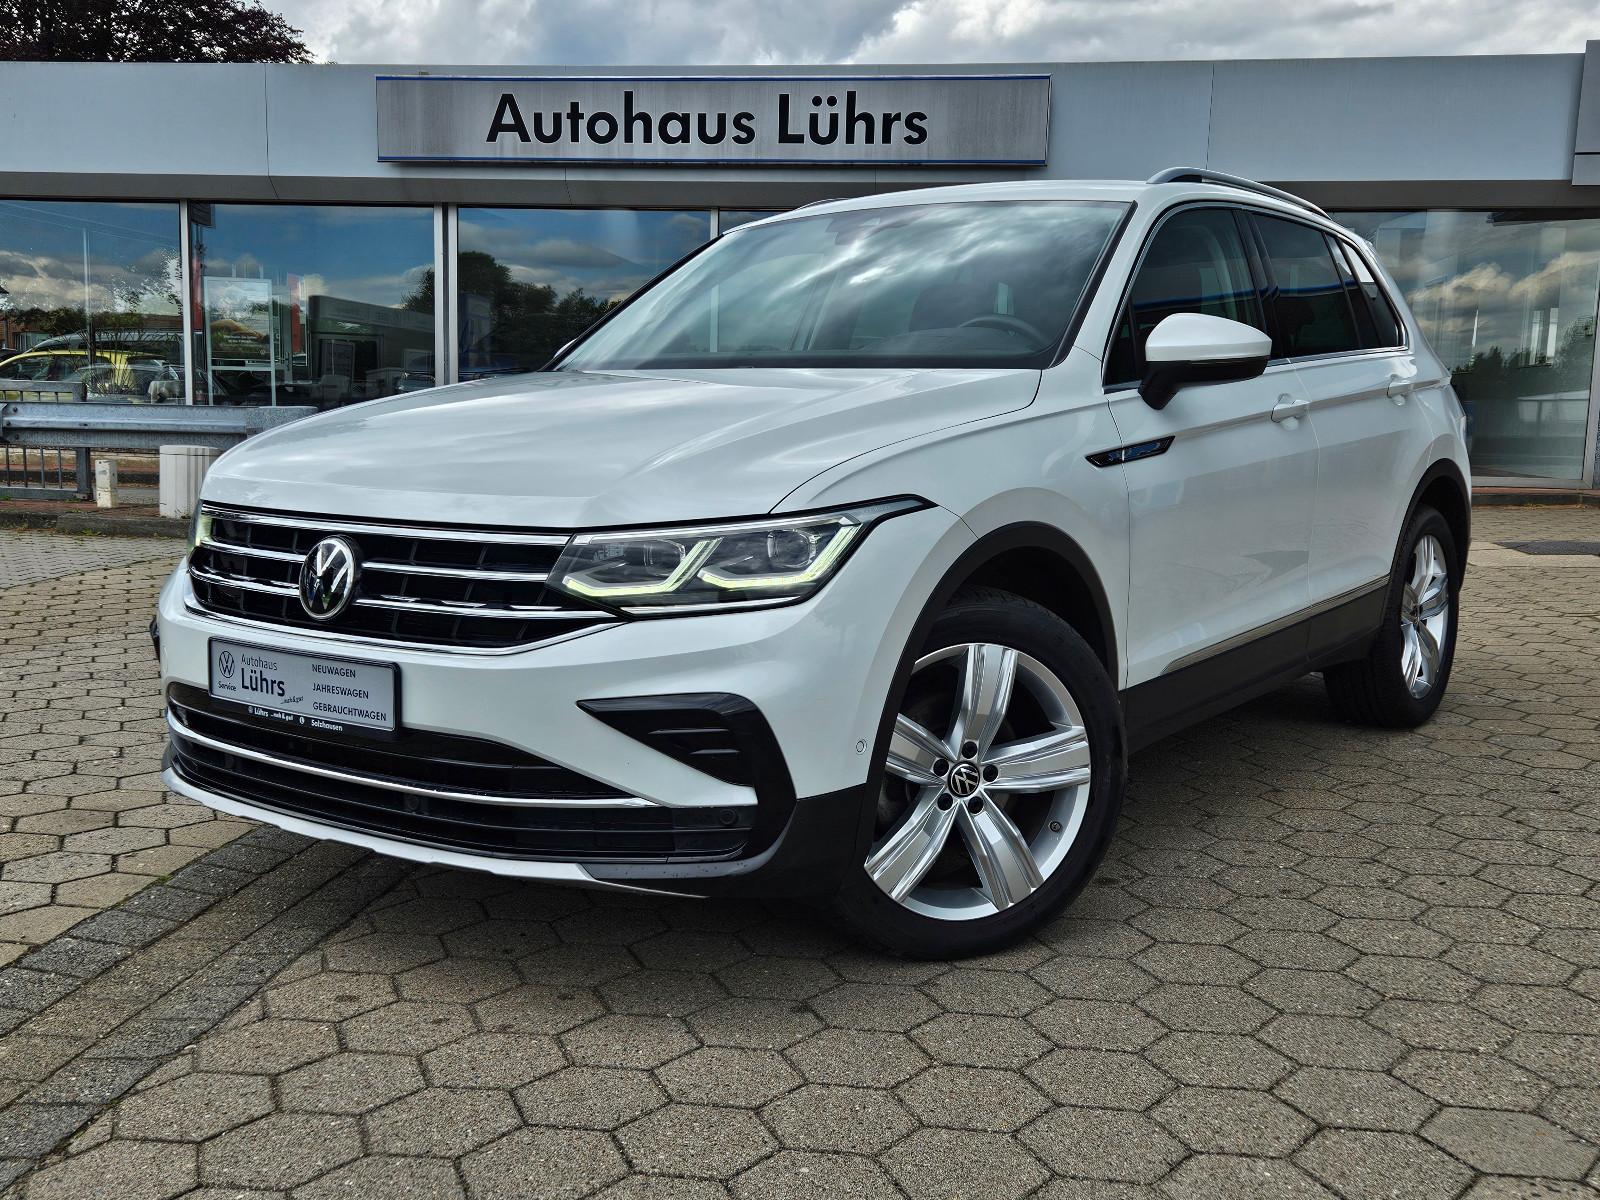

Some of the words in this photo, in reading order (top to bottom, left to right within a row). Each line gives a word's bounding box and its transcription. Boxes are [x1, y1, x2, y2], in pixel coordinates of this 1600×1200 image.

[486, 91, 756, 145] Autohaus
[778, 91, 928, 144] Lührs
[241, 654, 278, 671] Autohaus
[312, 664, 356, 678] NEUWAGEN
[218, 680, 237, 692] Service
[241, 668, 285, 697] Lührs
[312, 683, 369, 699] JAHRESWAGEN
[312, 702, 387, 721] GEBRAUCHTWAGEN
